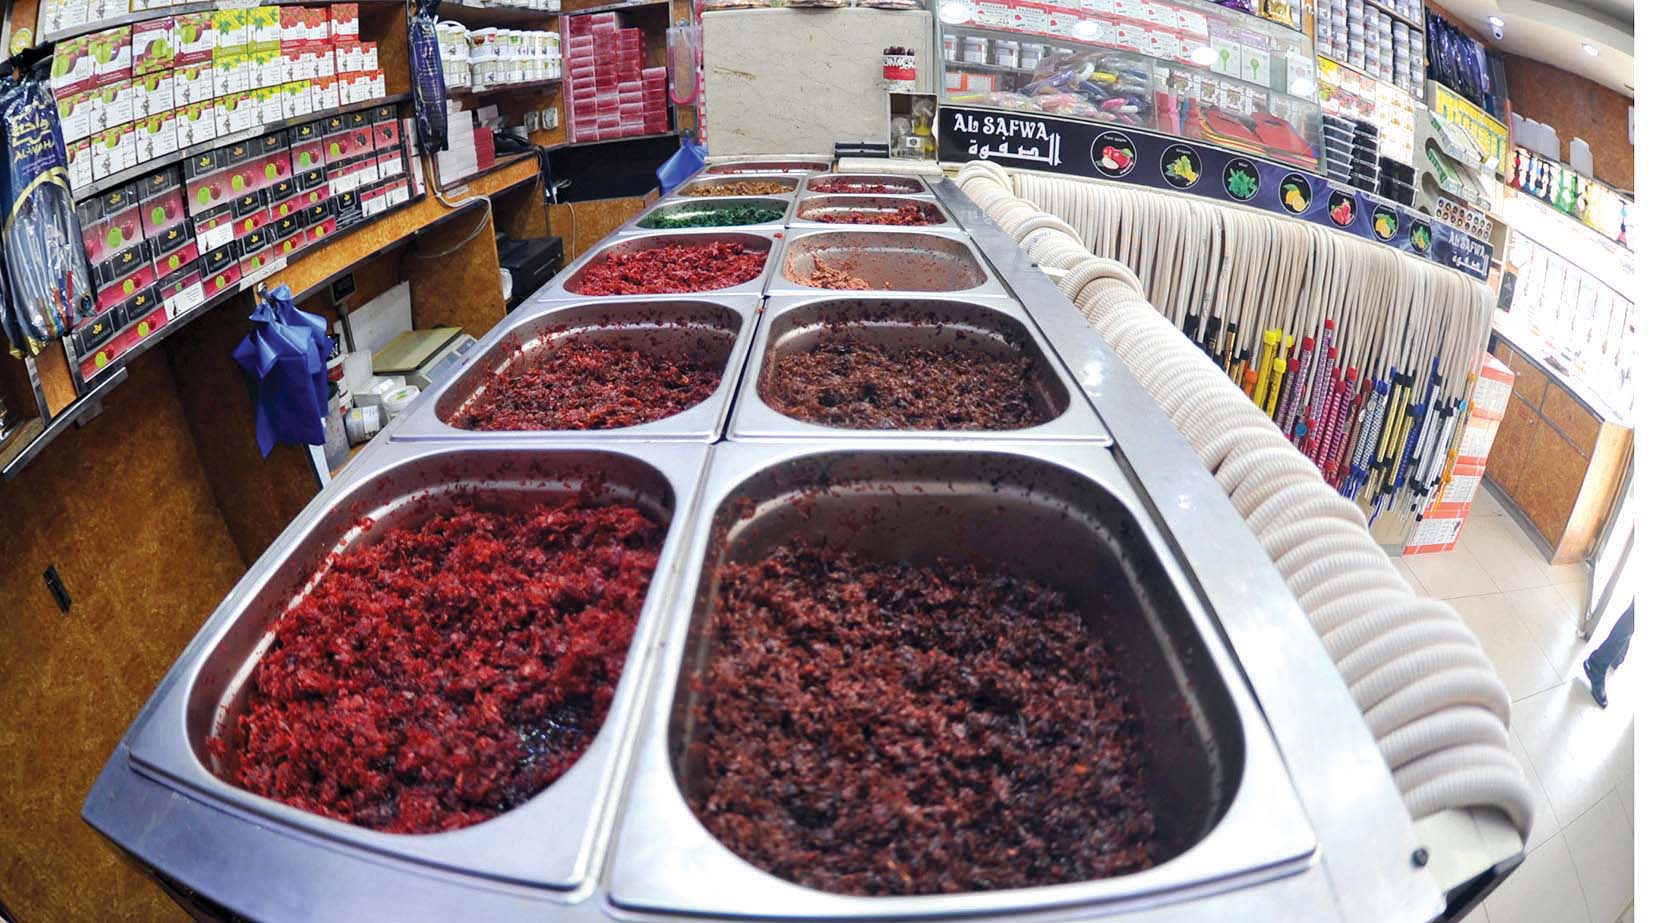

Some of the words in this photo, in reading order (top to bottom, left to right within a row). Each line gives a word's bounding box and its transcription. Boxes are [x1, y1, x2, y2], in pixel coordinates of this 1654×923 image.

[953, 113, 979, 133] AL
[982, 116, 1050, 141] SAFWA
[968, 133, 1062, 166] الصفوة
[1448, 231, 1460, 248] AL
